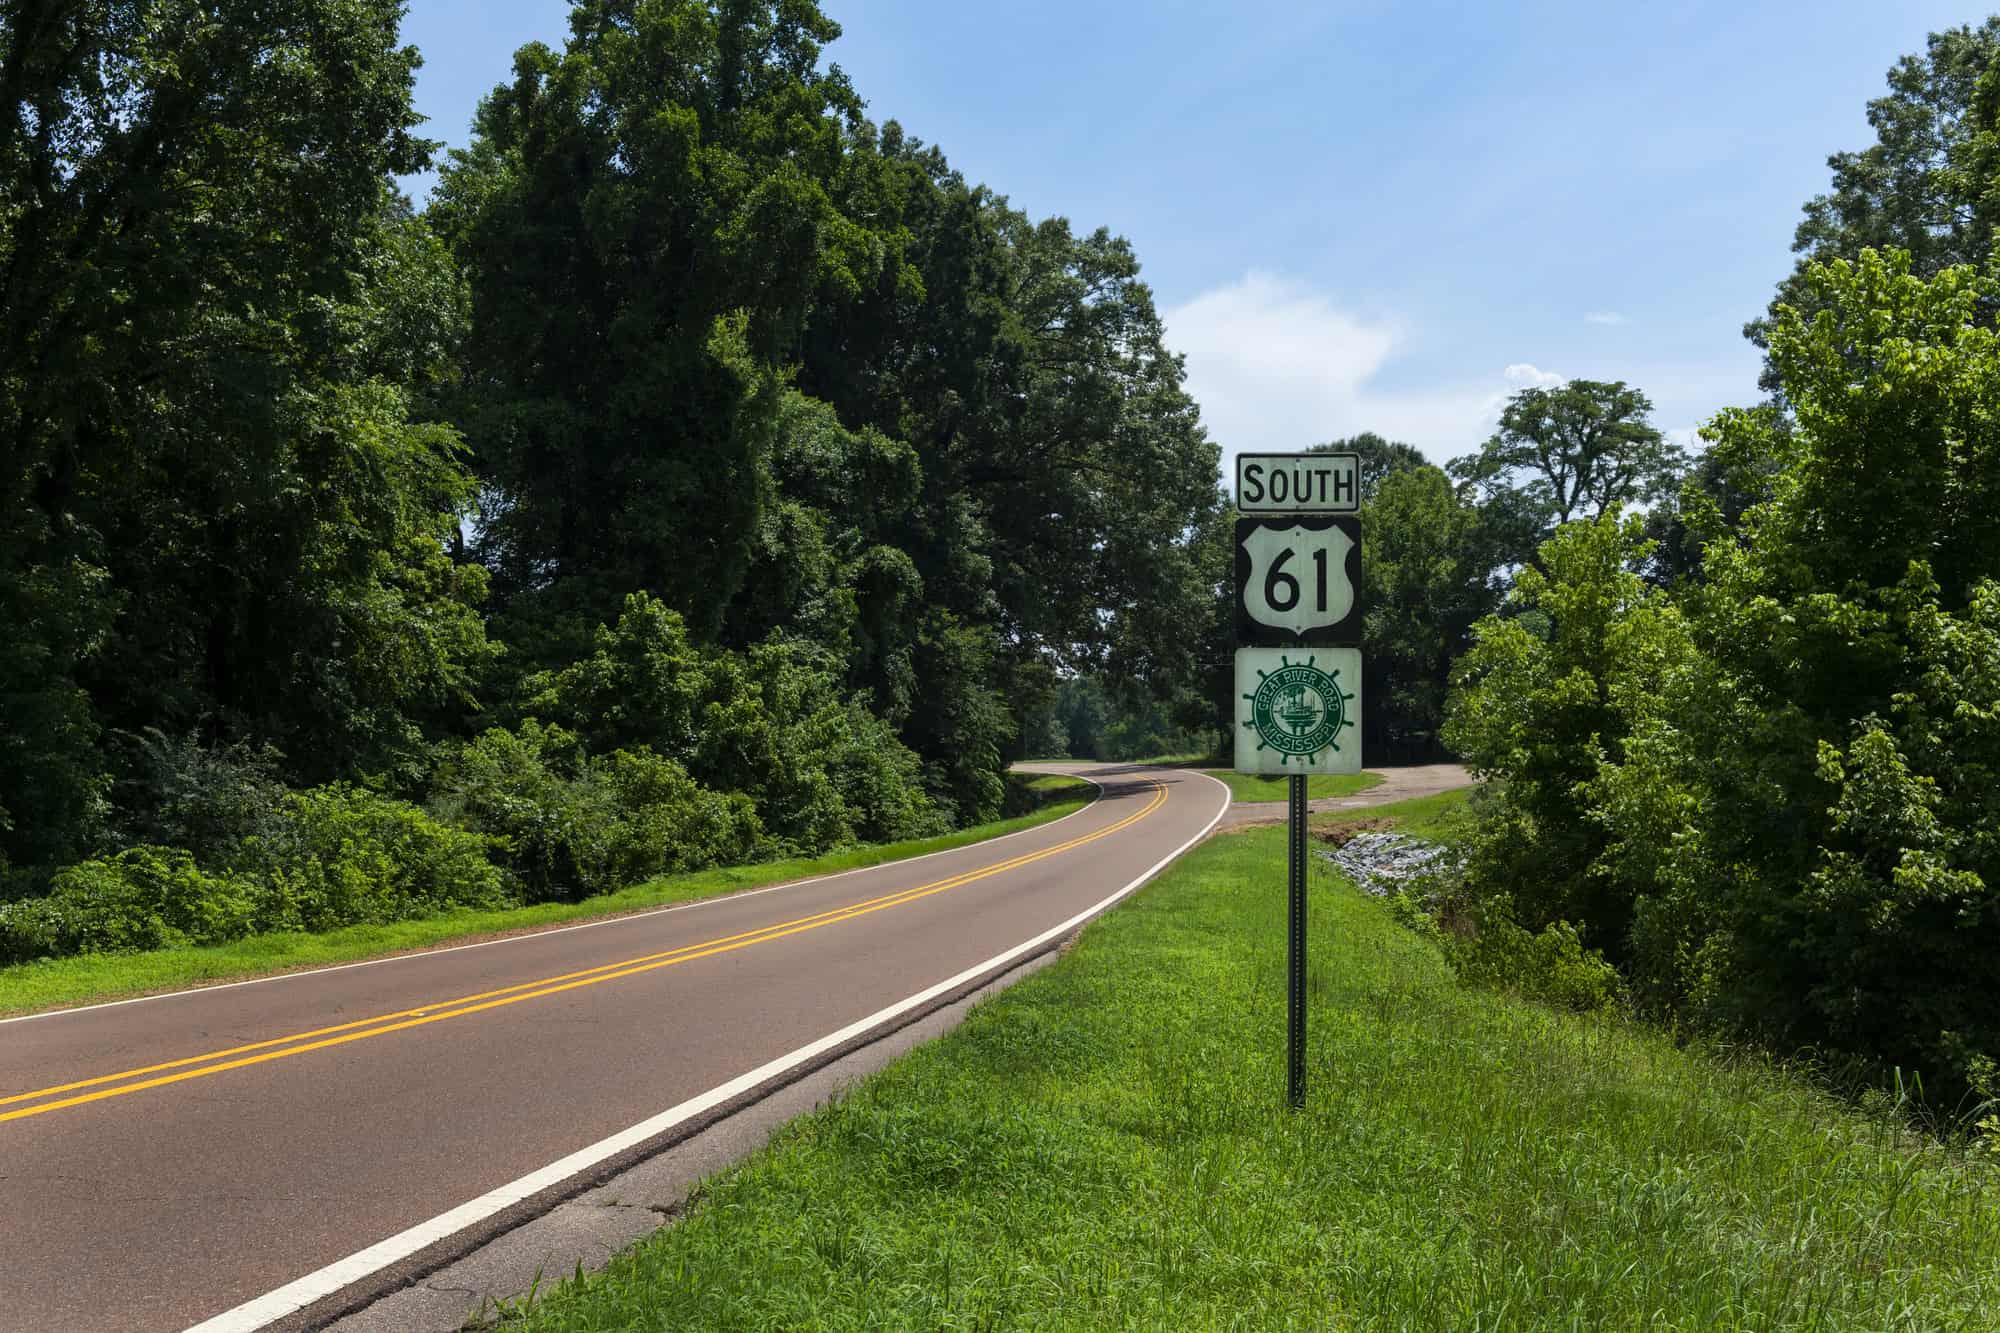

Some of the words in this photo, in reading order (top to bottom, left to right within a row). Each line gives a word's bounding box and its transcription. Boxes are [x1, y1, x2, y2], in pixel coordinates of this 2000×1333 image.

[1243, 464, 1353, 503] SOUTH
[1264, 547, 1327, 612] 61
[1258, 676, 1281, 711] GREAT
[1283, 670, 1318, 685] RIVER
[1319, 680, 1340, 711] ROAD
[1262, 722, 1336, 751] MISSISSIPPI
